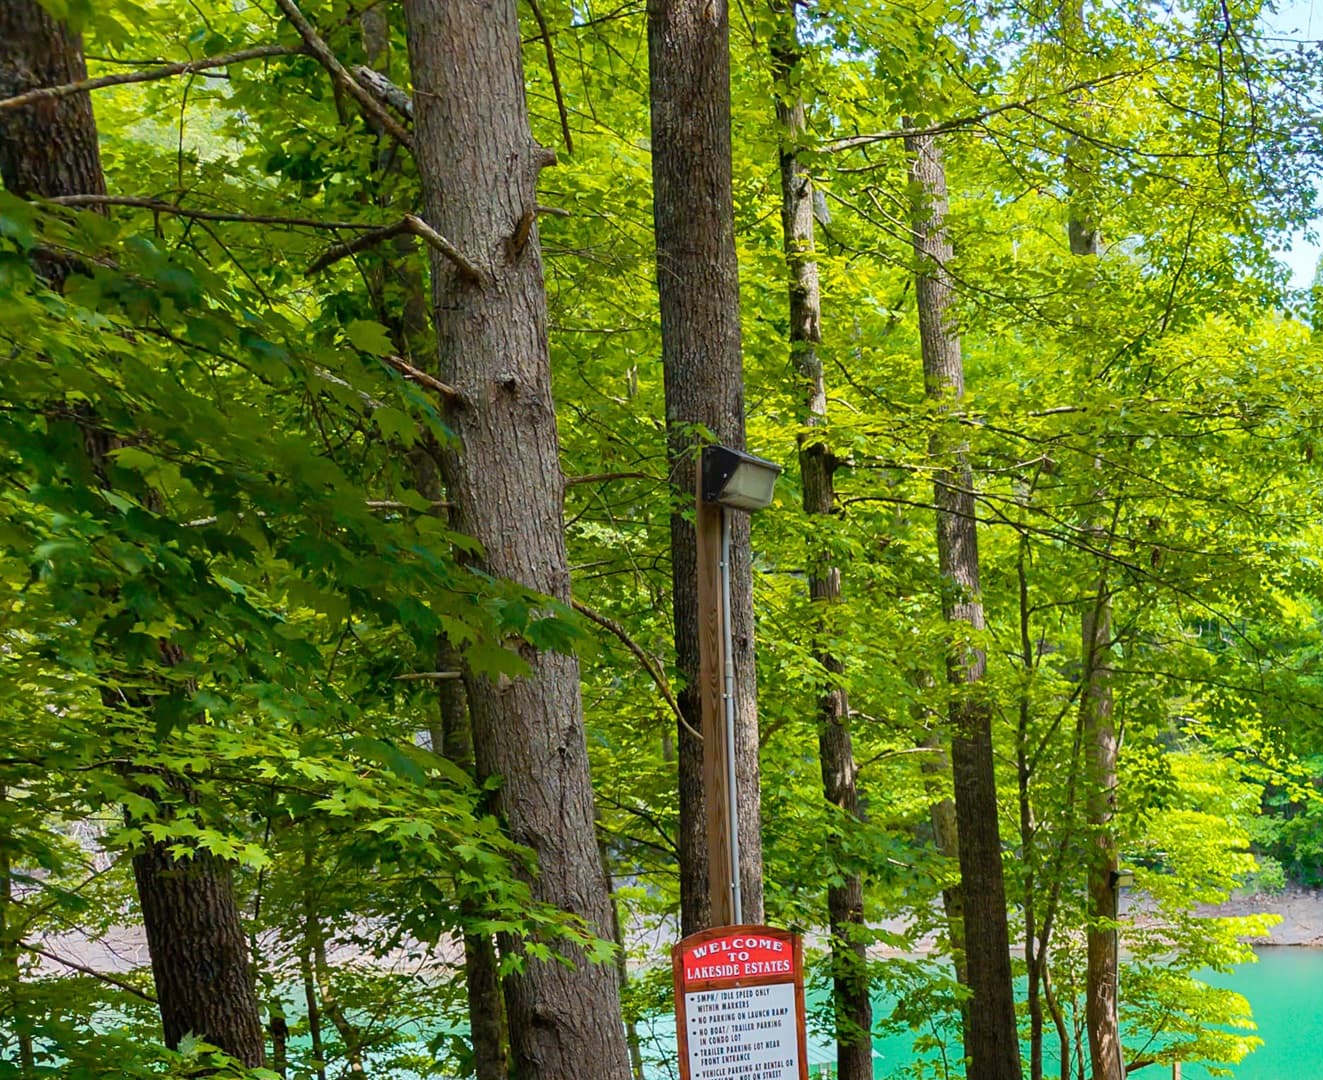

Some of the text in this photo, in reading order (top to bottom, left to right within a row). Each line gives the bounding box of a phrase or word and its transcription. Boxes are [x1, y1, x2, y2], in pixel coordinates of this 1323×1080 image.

[692, 938, 783, 959] WELCOME
[727, 951, 750, 962] TO
[687, 960, 790, 980] LAKESIDE ESTATES
[721, 991, 734, 1000] IDLE
[735, 989, 753, 999] SPEED
[755, 988, 769, 997] ONLY
[697, 1000, 749, 1012] WITHIN MARKERS
[698, 1008, 788, 1024] NO PARKING ON LAUNCH RAMP
[699, 1028, 708, 1036] NO
[731, 1022, 754, 1032] TRAILER
[756, 1020, 782, 1030] PARKING
[700, 1033, 741, 1046] IN CONDO LOT
[700, 1040, 780, 1057] TRAILER PARKING LOT NEAR
[701, 1053, 750, 1066] FRONT ENTRANCE
[702, 1059, 793, 1079] VEHICLE PARKING AT RENTAL OR
[752, 1073, 761, 1080] ON
[762, 1070, 782, 1080] STREET
